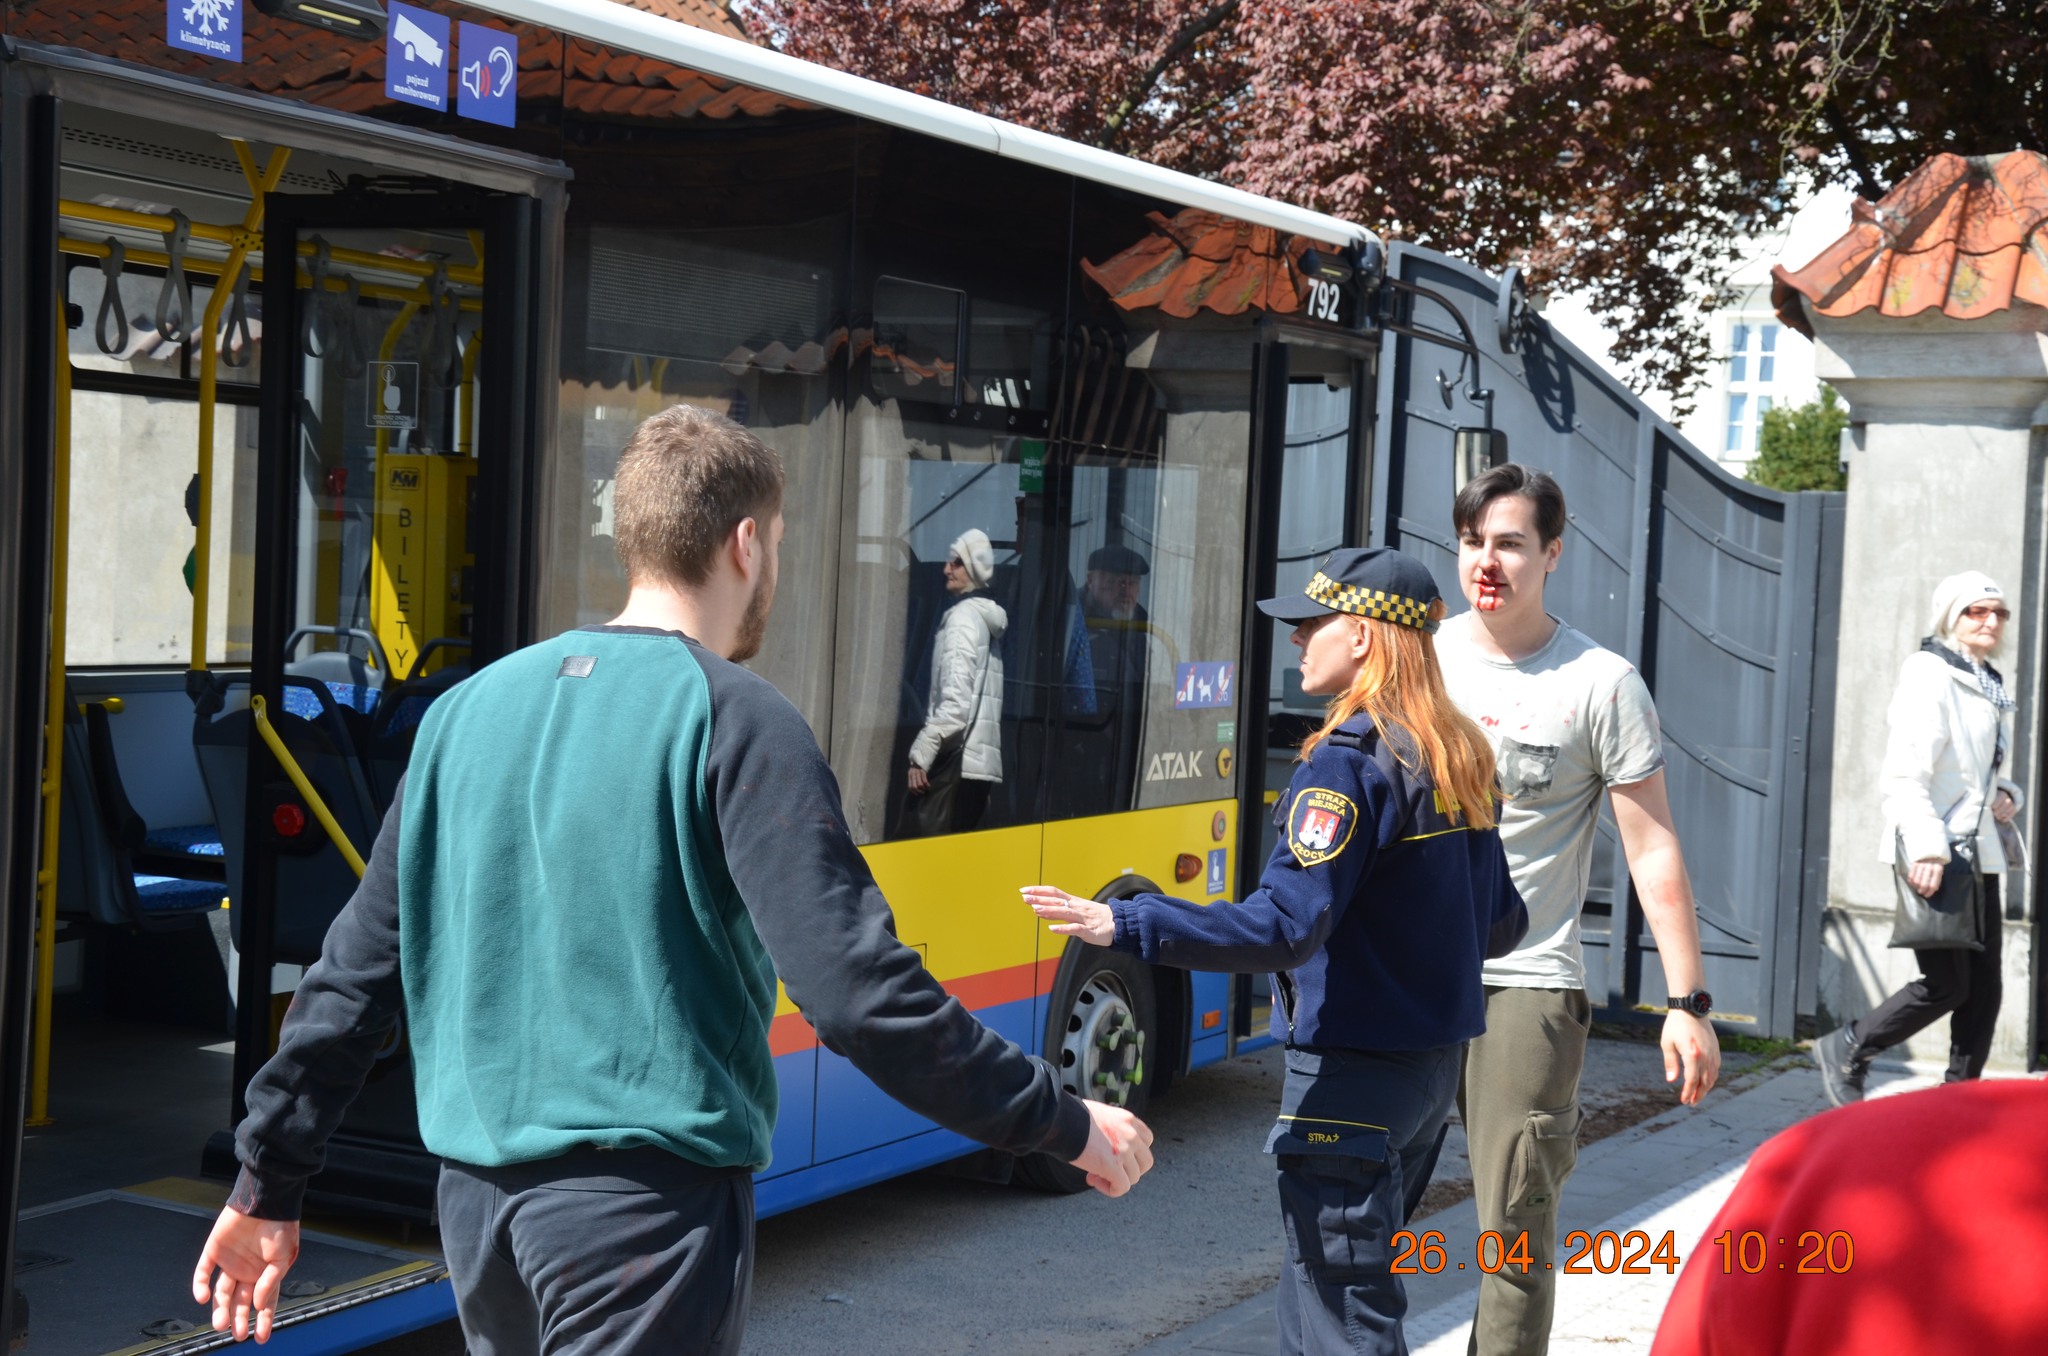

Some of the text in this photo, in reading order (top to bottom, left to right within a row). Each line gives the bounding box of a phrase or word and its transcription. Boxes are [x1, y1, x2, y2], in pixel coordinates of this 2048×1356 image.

[180, 29, 231, 54] klimatyzacja
[406, 74, 429, 88] pojazd
[393, 84, 440, 105] monitorowany
[1308, 278, 1340, 322] 792
[395, 508, 412, 668] BILETY
[1145, 750, 1203, 782] ATAK
[1308, 799, 1346, 816] MIEJSKA
[1315, 792, 1346, 807] STRAŻ
[1294, 842, 1325, 859] PŁOCK
